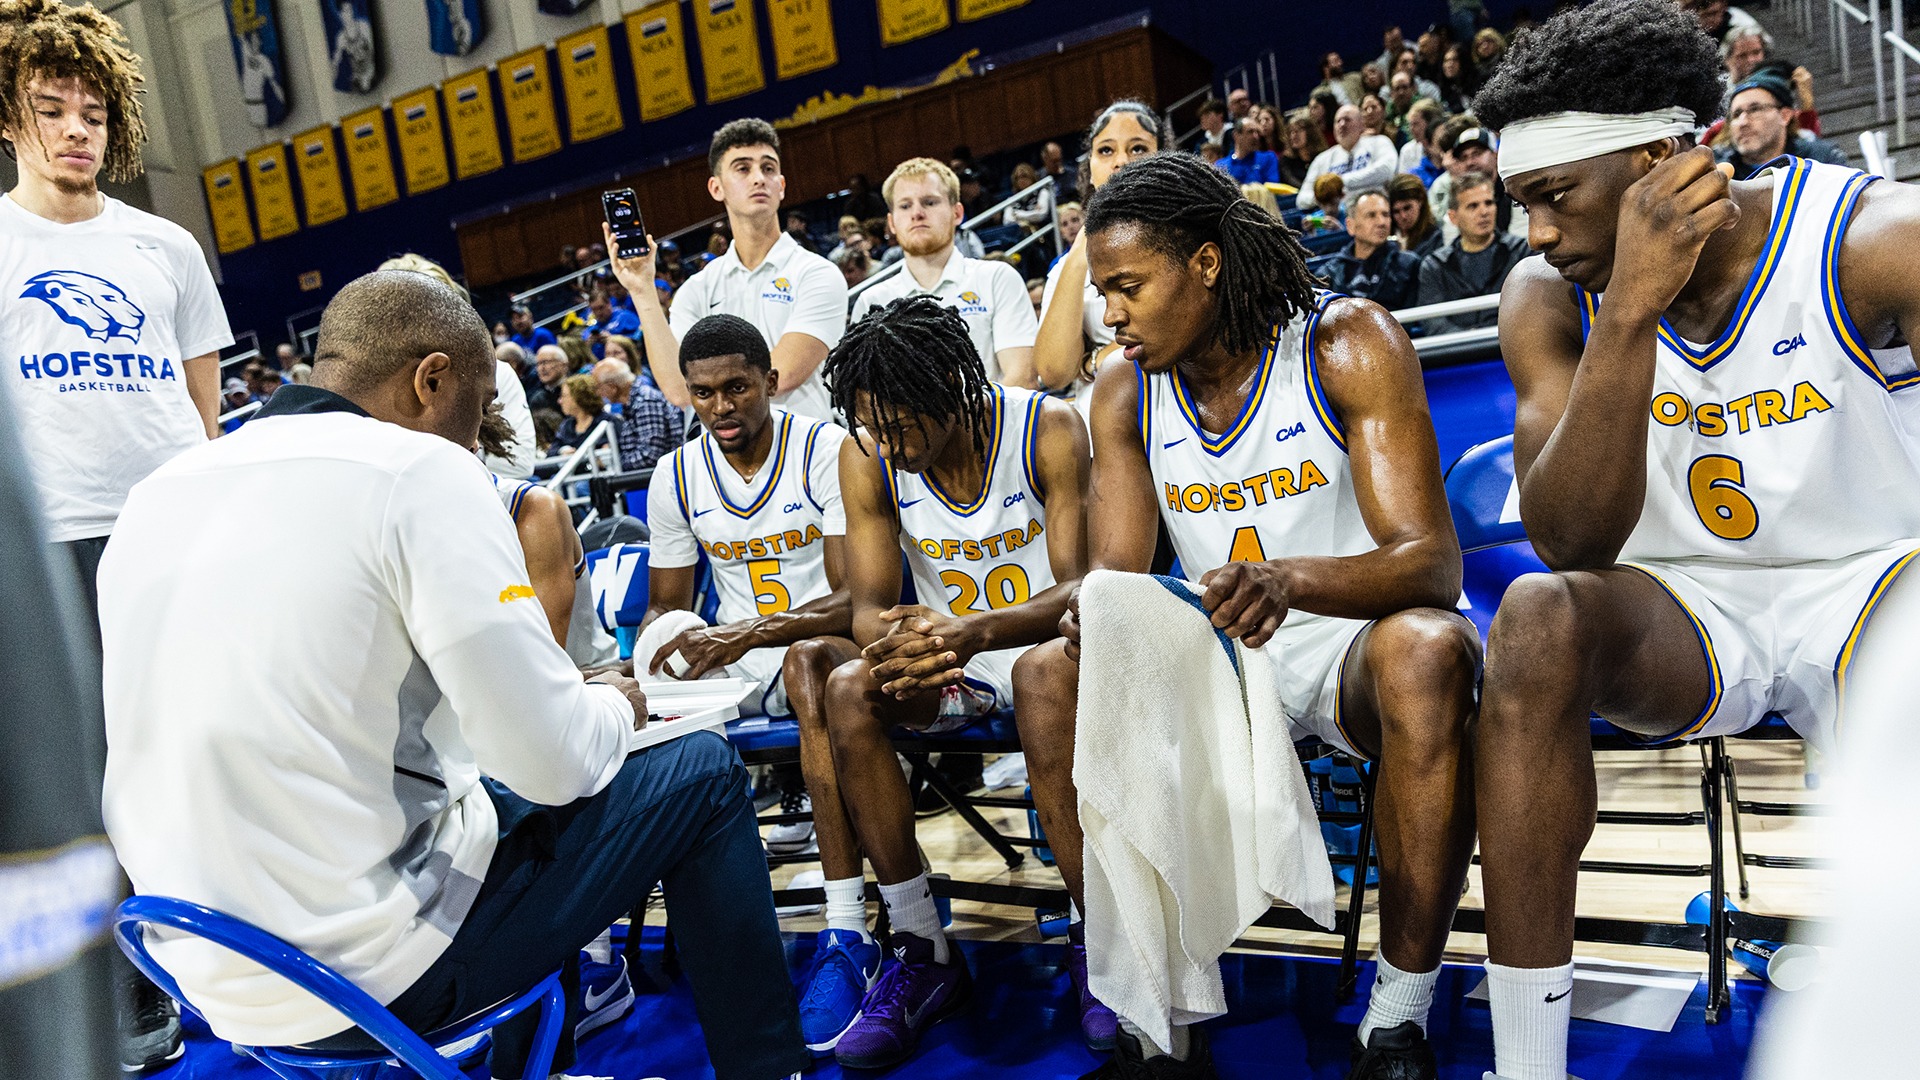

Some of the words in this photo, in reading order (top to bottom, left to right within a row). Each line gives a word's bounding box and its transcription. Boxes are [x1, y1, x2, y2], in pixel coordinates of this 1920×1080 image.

[1772, 332, 1808, 357] CAA
[19, 350, 177, 382] HOFSTRA
[59, 381, 152, 394] BASKETBALL
[1650, 380, 1835, 437] OSTRA
[1275, 421, 1307, 442] CAA
[1003, 490, 1026, 508] CAA
[1687, 453, 1760, 541] 6
[747, 559, 792, 617] 5
[938, 562, 1032, 617] 20
